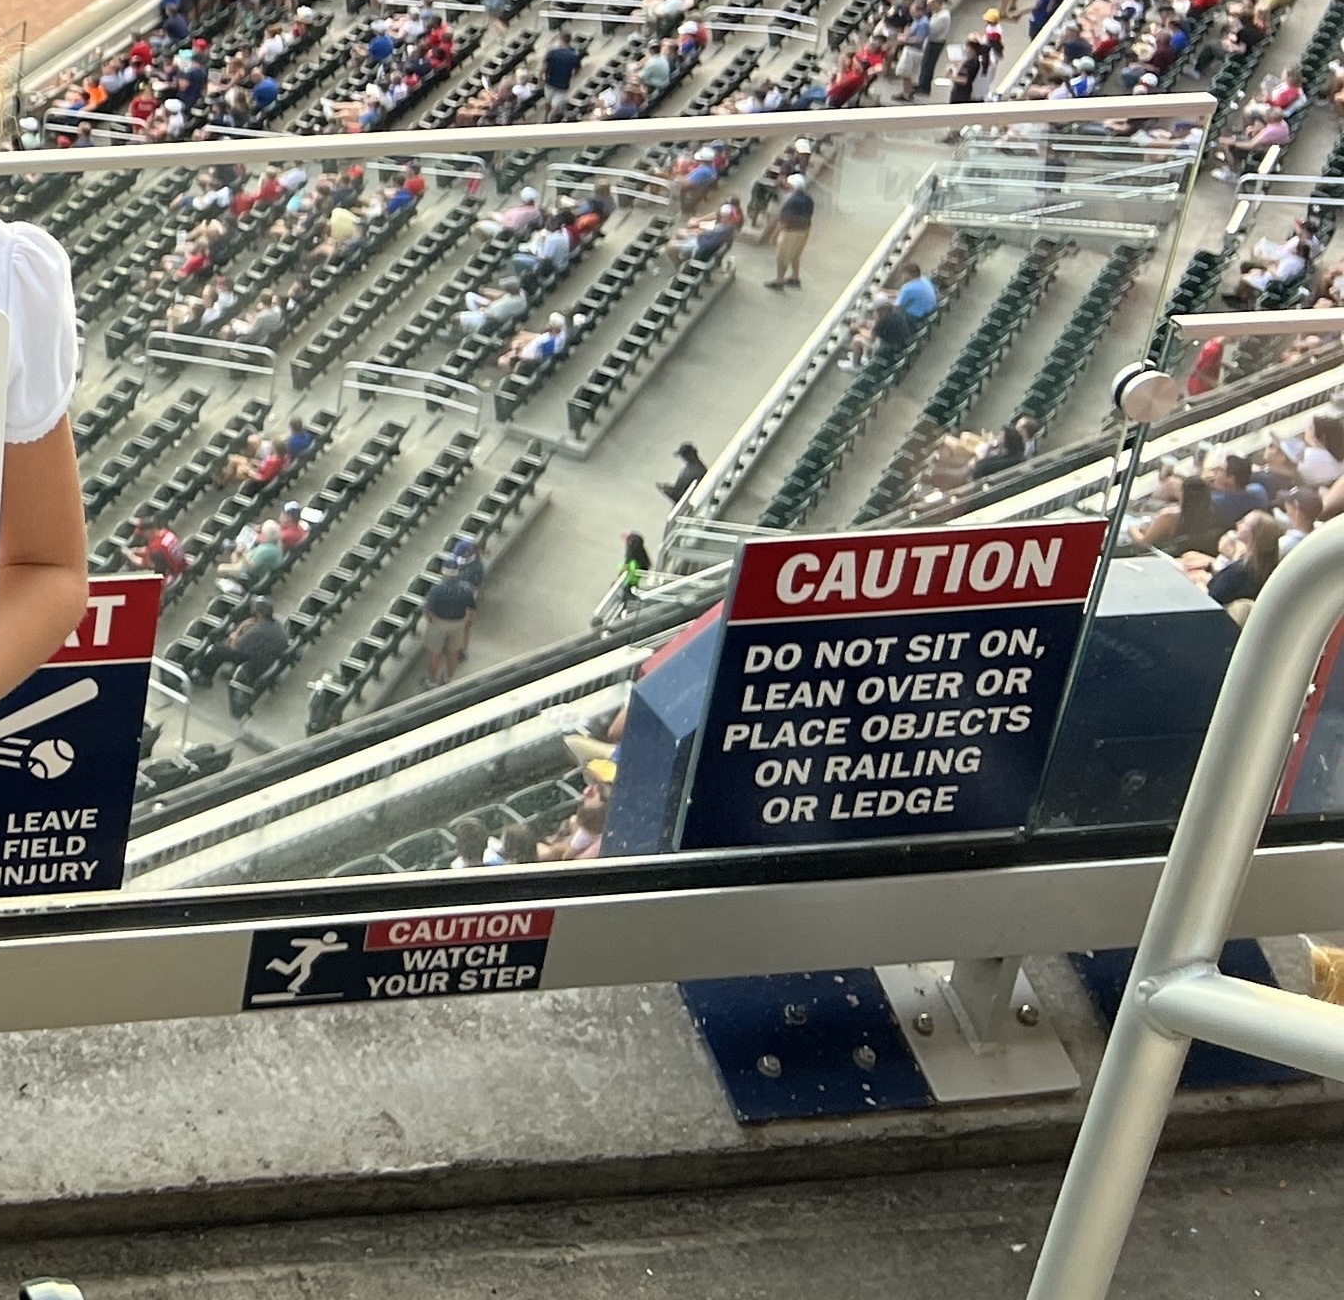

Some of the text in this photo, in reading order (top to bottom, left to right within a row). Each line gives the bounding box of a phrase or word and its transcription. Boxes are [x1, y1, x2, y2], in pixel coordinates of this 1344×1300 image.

[775, 537, 1064, 605] CAUTION
[743, 627, 1046, 674] DO NOT SIT ON,
[740, 668, 1033, 713] LEAN OVER OR
[722, 705, 1033, 753] PLACE OBJECTS
[754, 746, 982, 788] ON RAILING
[7, 808, 99, 834] LEAVE
[761, 786, 960, 825] OR LEDGE
[2, 835, 87, 859] FIELD
[388, 913, 533, 944] CAUTION
[402, 944, 508, 972] WATCH
[367, 966, 537, 998] YOUR STEP
